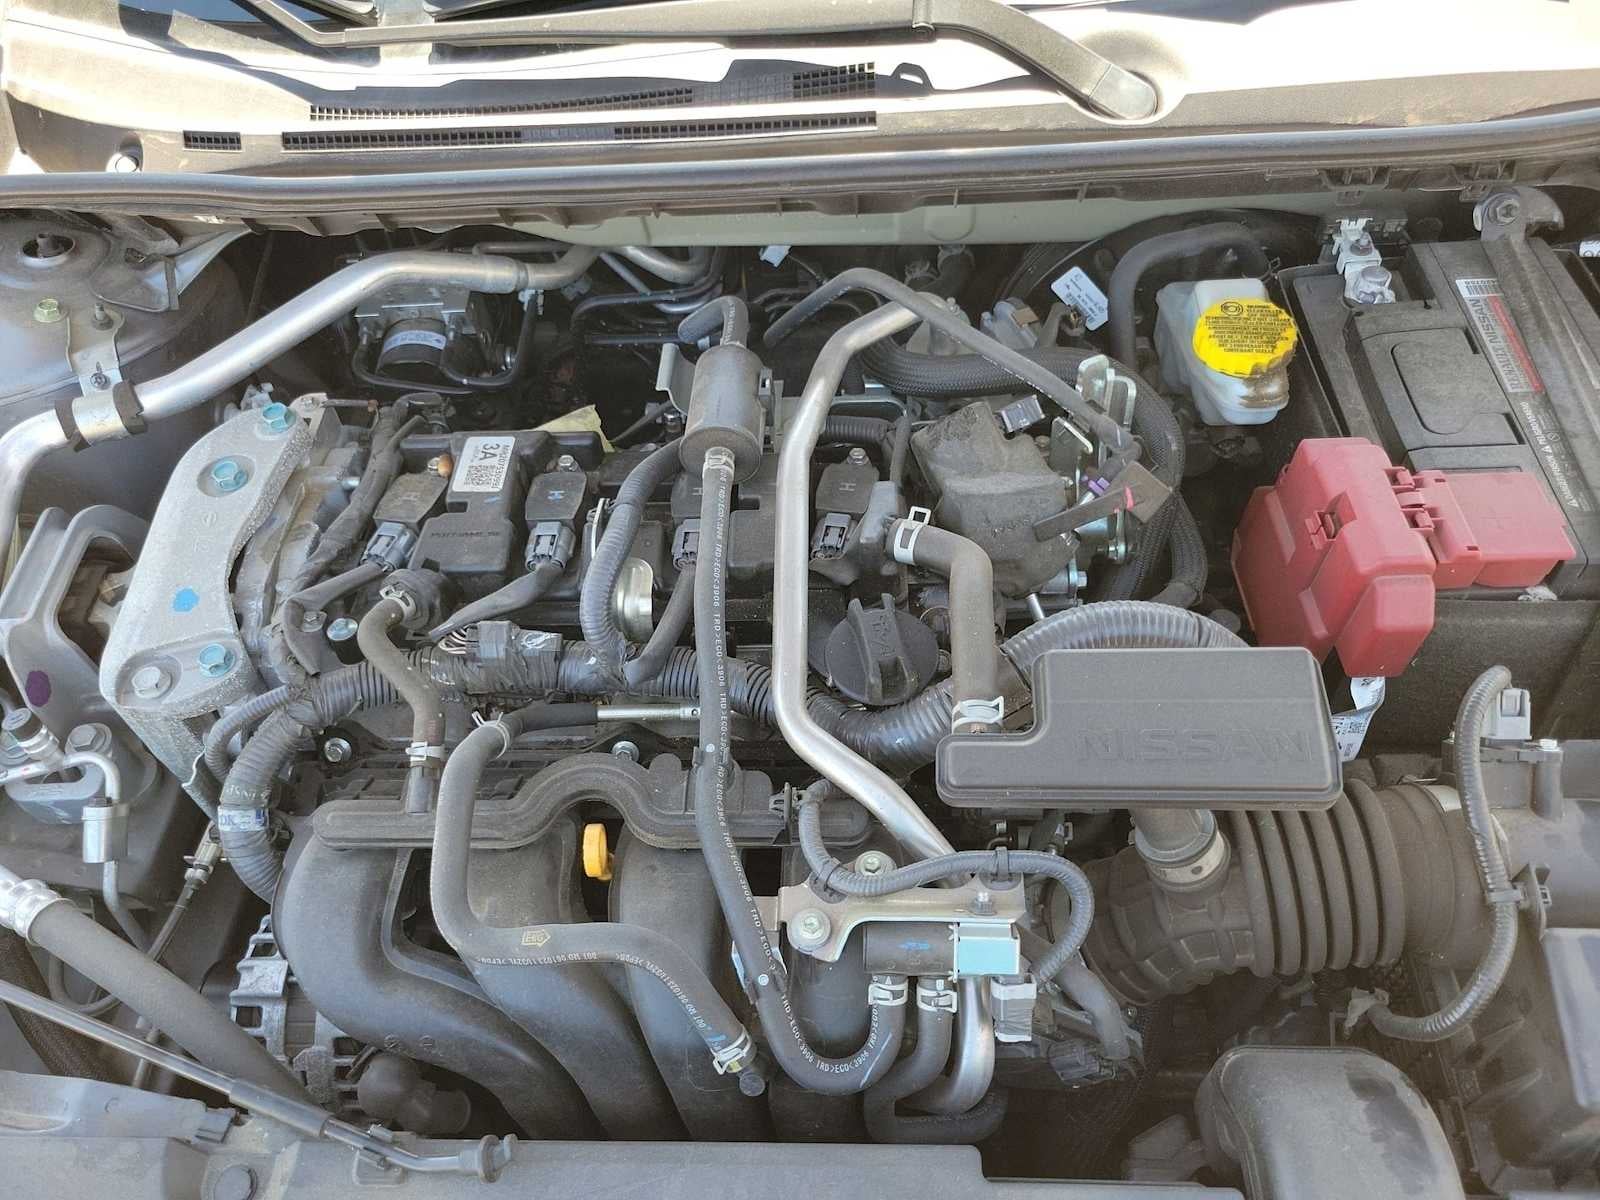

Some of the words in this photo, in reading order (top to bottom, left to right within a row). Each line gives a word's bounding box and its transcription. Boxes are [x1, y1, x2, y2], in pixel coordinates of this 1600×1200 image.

[1469, 299, 1501, 344] NISSAN
[479, 443, 501, 461] 3A
[1076, 728, 1313, 762] NISSAN
